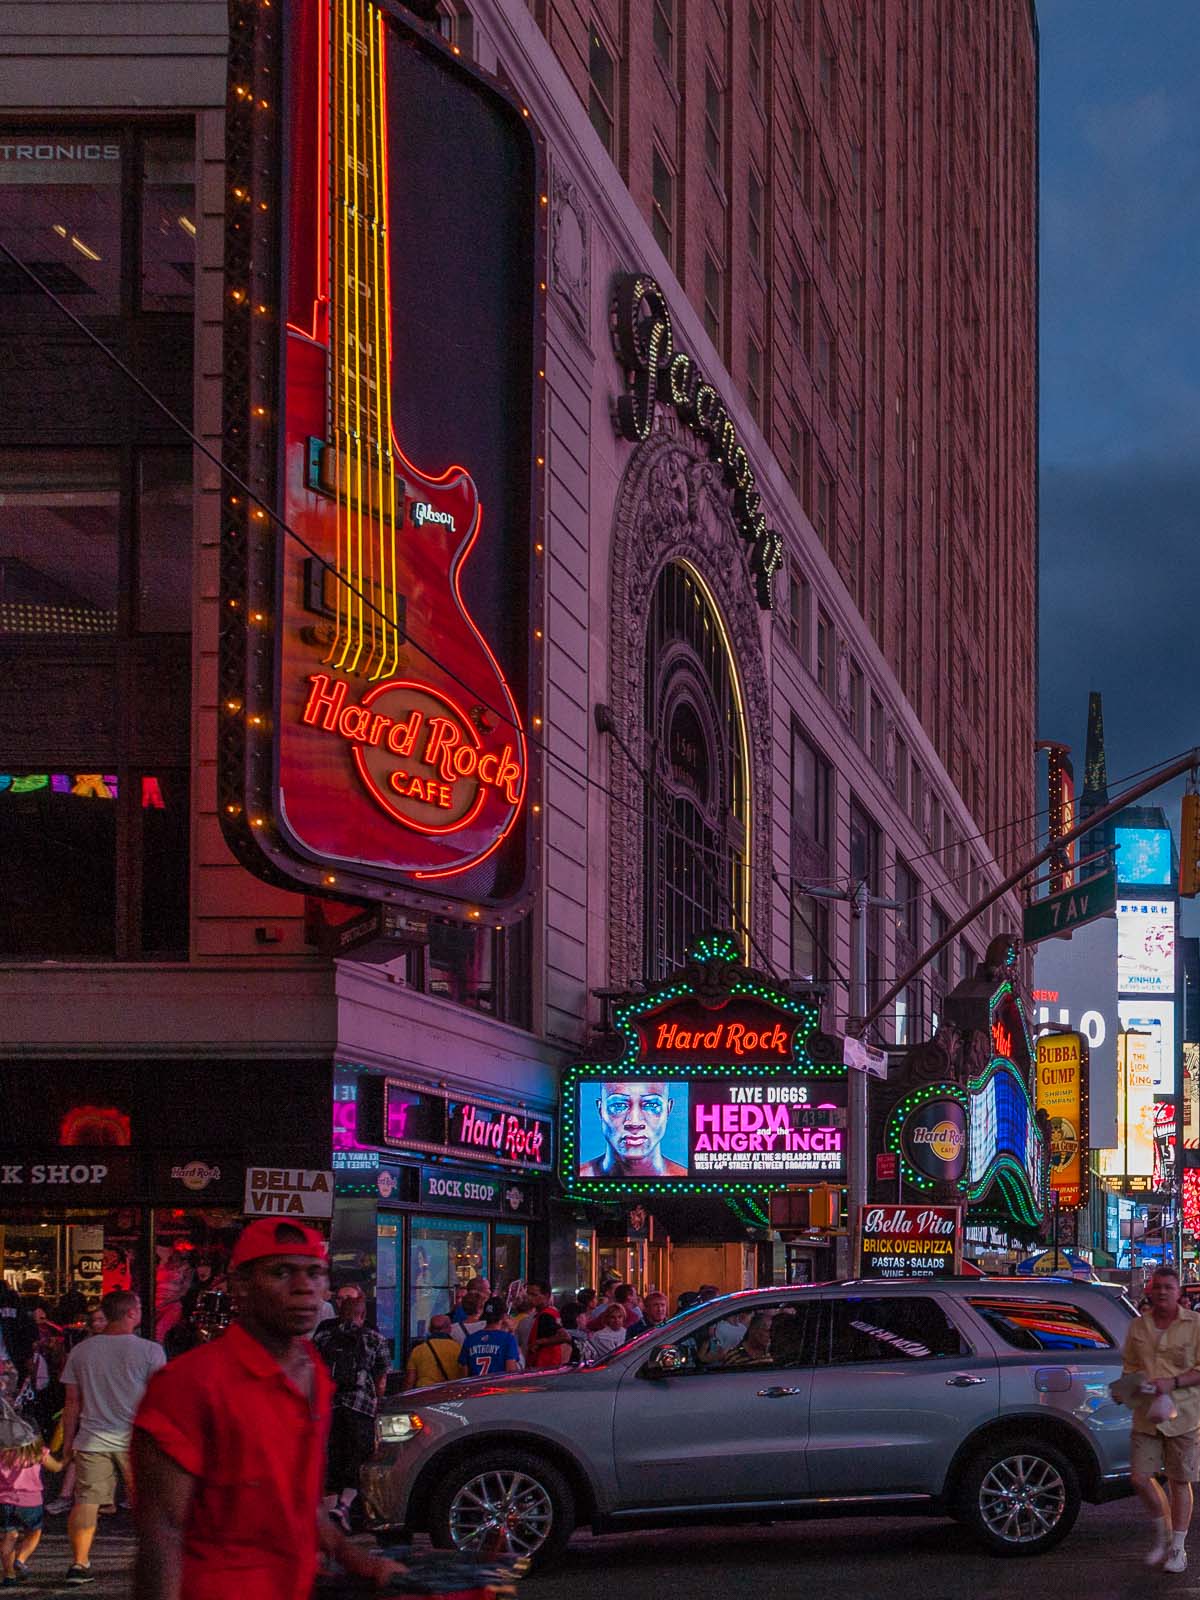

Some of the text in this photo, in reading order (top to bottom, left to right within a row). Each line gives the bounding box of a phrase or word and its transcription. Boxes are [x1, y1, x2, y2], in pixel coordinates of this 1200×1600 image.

[415, 503, 456, 532] Gibson
[303, 674, 521, 804] Hard Rock
[390, 771, 453, 810] CAFE
[1051, 895, 1089, 927] 7 AV
[1128, 976, 1162, 984] XINHUA
[656, 1023, 787, 1055] Hard Rock
[1038, 1045, 1078, 1064] BUBBA
[1041, 1067, 1076, 1086] GUMP
[729, 1087, 808, 1104] TAYE DIGGS
[461, 1104, 543, 1163] Hard Rock
[694, 1132, 841, 1151] ANGRY INCH
[756, 1127, 790, 1136] and the
[913, 1127, 948, 1144] Hard
[31, 1164, 108, 1184] SHOP
[250, 1170, 330, 1193] BELLA
[428, 1177, 462, 1198] ROCK
[463, 1182, 495, 1201] SHOP
[250, 1192, 305, 1214] VITA
[864, 1208, 913, 1236] Bella
[916, 1210, 955, 1235] Vita
[863, 1238, 953, 1255] BRICK OVEN PIZZA
[871, 1257, 945, 1269] PASTAS SALADS
[475, 1356, 492, 1377] 7
